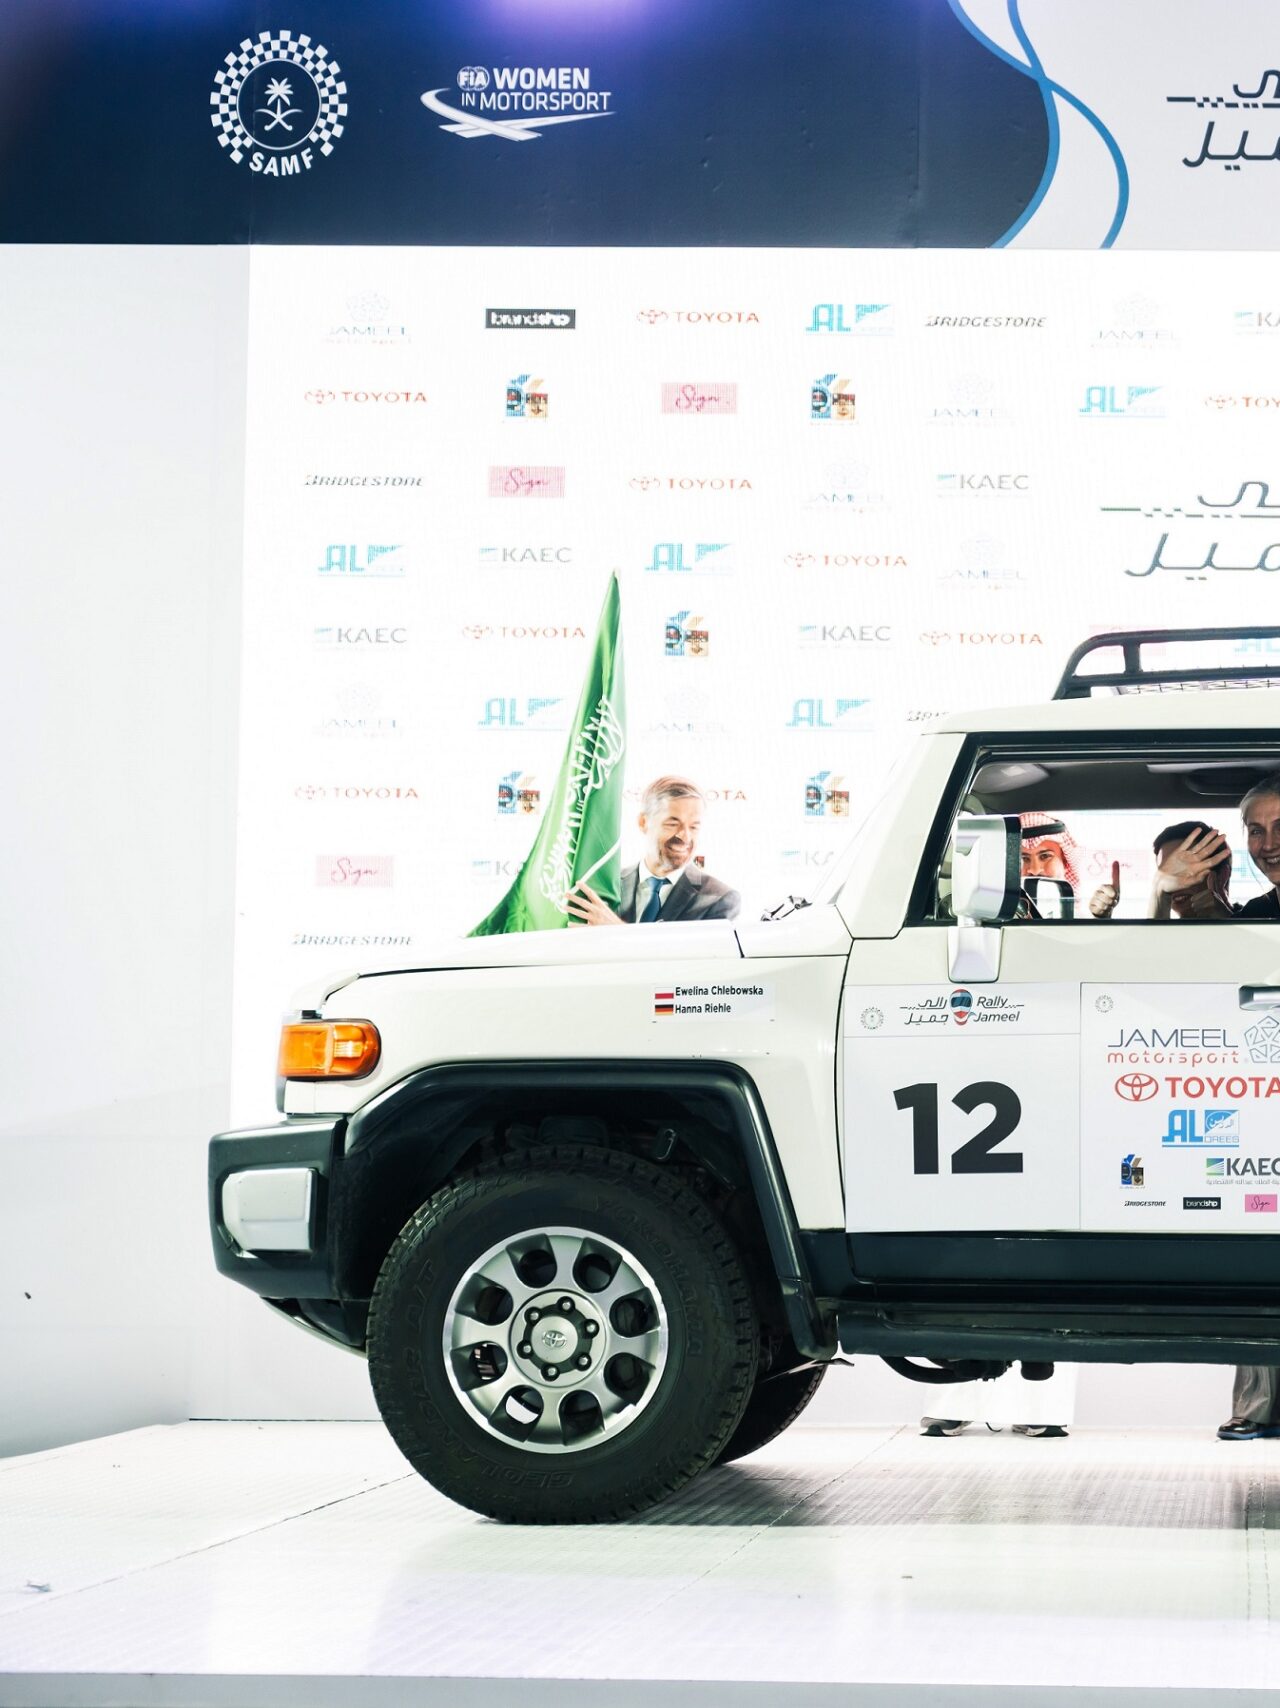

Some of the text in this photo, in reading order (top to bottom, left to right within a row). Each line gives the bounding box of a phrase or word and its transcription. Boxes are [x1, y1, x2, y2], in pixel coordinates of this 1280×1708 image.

[493, 67, 590, 90] WOMEN
[461, 92, 611, 111] IN MOTORSPORT
[249, 148, 315, 177] SAMF
[676, 311, 760, 324] TOYOTA
[342, 391, 427, 404] TOYOTA
[667, 478, 752, 491] TOYOTA
[960, 474, 1029, 490] KAEC
[501, 547, 572, 563] KAEC
[824, 554, 907, 567] TOYOTA
[337, 627, 407, 643] KAEC
[500, 626, 585, 639] TOYOTA
[821, 625, 891, 641] KAEC
[959, 632, 1043, 645] TOYOTA
[334, 786, 418, 799] TOYOTA
[675, 985, 764, 996] Ewelina Chlebowska
[675, 1003, 732, 1013] Hanna Riehle
[976, 996, 1008, 1009] Rally
[904, 1012, 949, 1025] جميل
[973, 1011, 1021, 1023] Jameel
[1108, 1029, 1239, 1048] JAMEEL
[1107, 1050, 1239, 1067] motorsport
[892, 1080, 1025, 1176] 12
[1162, 1109, 1203, 1143] AL
